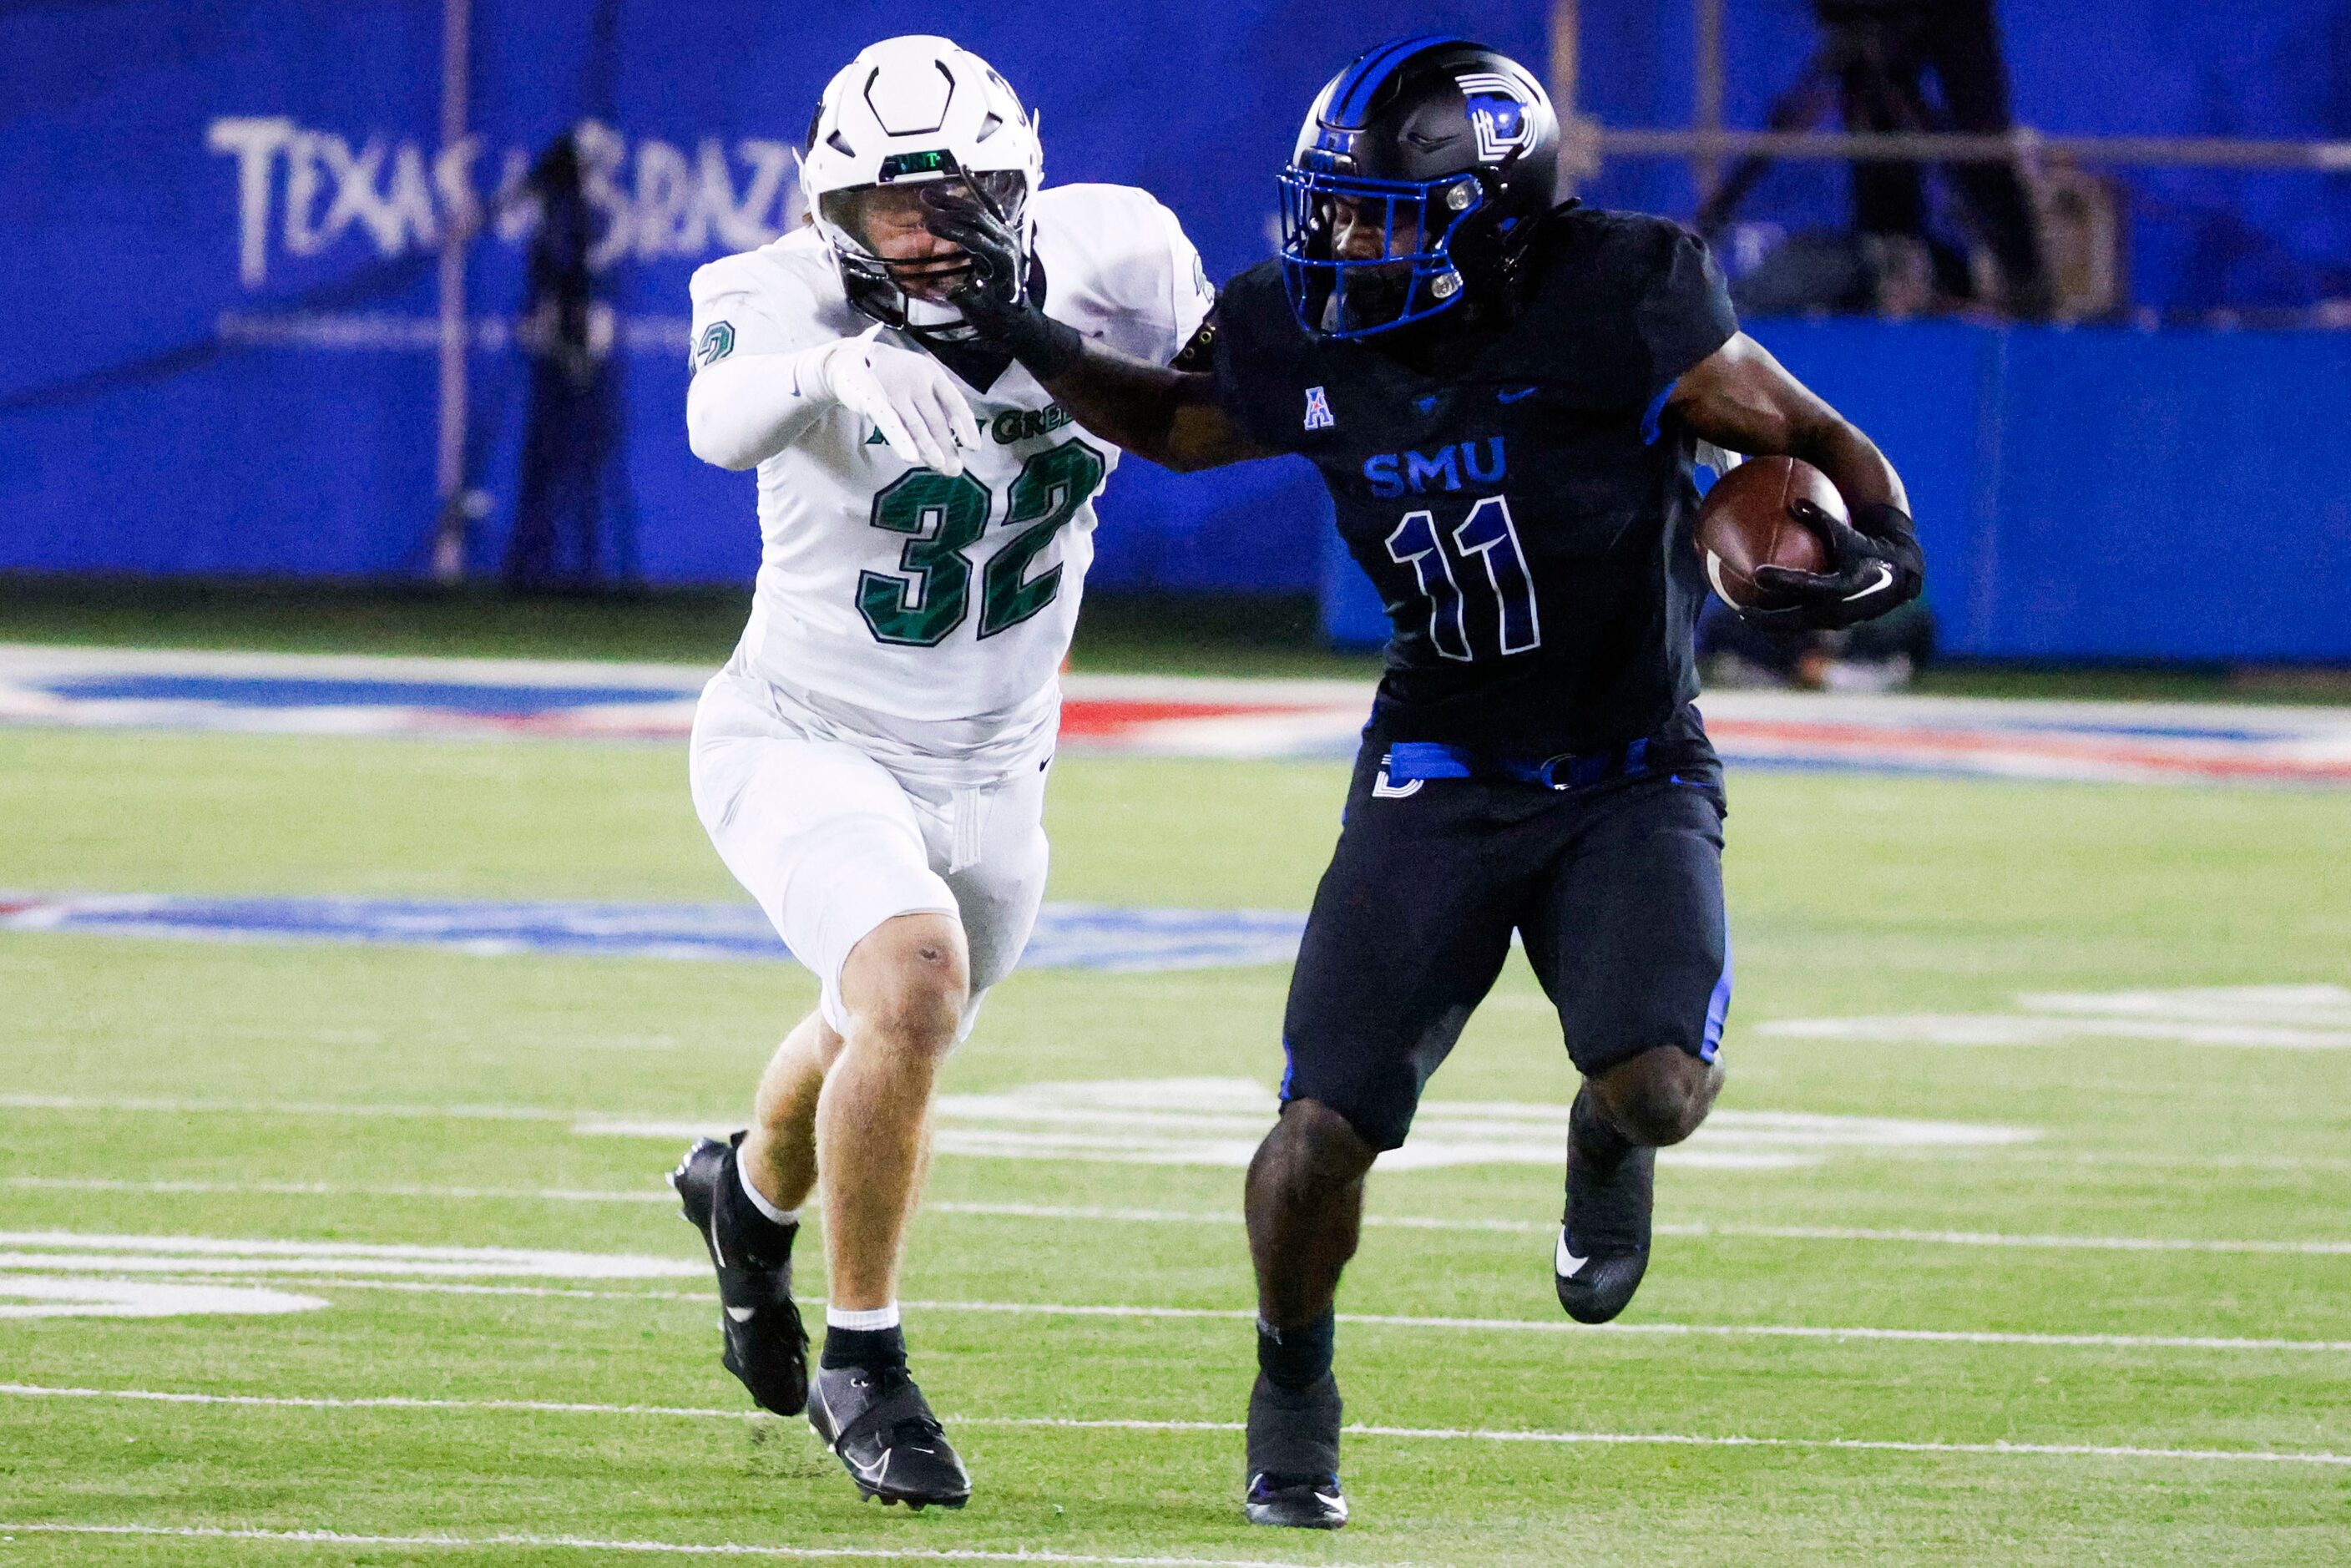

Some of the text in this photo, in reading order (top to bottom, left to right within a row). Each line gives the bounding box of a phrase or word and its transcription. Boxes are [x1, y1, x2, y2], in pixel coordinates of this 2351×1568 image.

[207, 116, 486, 286] TEXAS
[855, 436, 1105, 647] 32
[1363, 436, 1507, 498] SMU
[1384, 494, 1541, 662] 11
